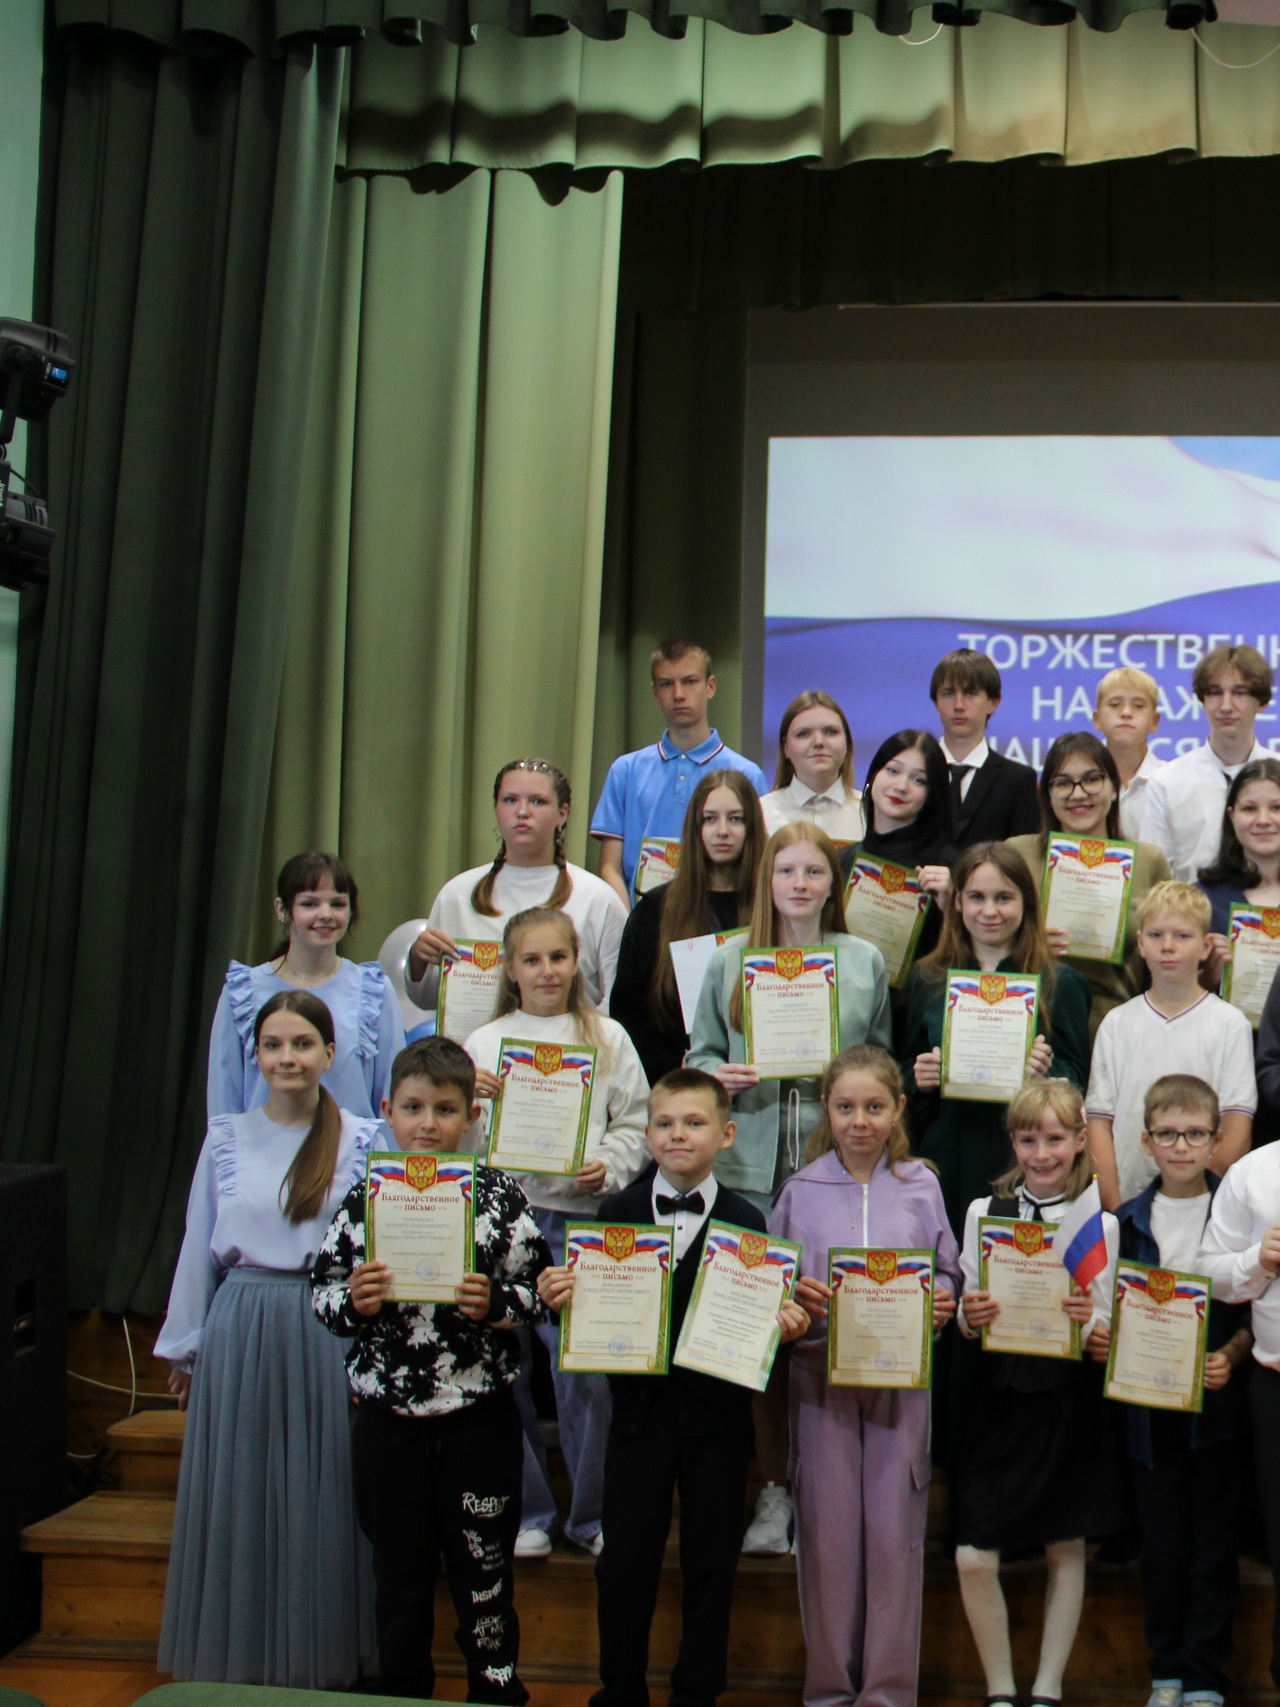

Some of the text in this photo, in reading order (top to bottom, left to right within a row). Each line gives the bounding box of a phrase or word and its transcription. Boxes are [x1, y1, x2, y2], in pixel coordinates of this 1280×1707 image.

[756, 982, 825, 992] Благодарственное
[511, 1073, 580, 1088] Благодарственное
[381, 1192, 460, 1204] Благодарственное
[404, 1203, 436, 1211] письмо
[580, 1261, 657, 1273] Благодарственное
[602, 1273, 634, 1281] письмо
[713, 1261, 780, 1288] Благодарственное
[731, 1276, 759, 1291] письмо
[843, 1285, 919, 1296] Благодарственное
